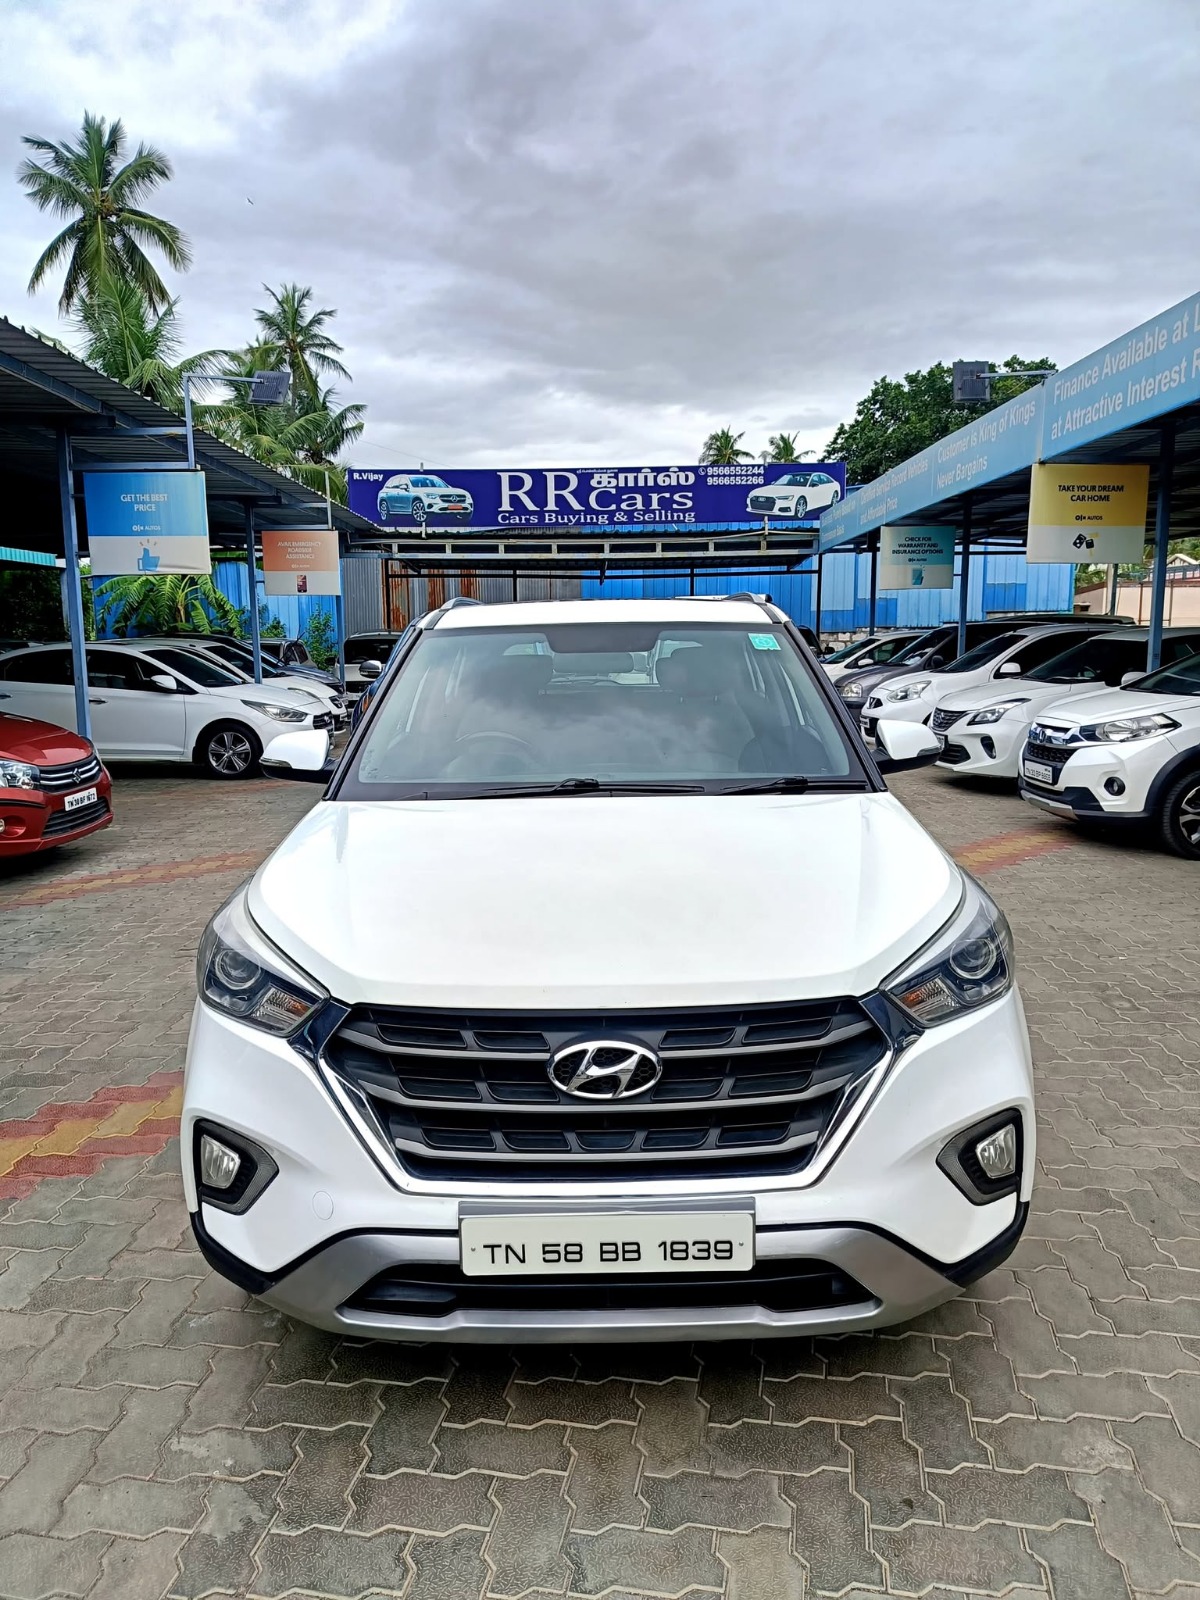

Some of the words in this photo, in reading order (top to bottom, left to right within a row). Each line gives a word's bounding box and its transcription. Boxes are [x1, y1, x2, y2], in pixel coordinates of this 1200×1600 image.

[1054, 365, 1099, 405] Finance
[1101, 326, 1168, 380] Available
[1172, 311, 1189, 344] at
[1051, 416, 1062, 440] at
[1063, 391, 1123, 435] Attractive
[1127, 356, 1187, 407] Interest
[937, 435, 970, 463] Customer
[970, 430, 978, 448] is
[979, 421, 997, 442] King
[998, 410, 1008, 433] of
[1009, 400, 1036, 428] Kings
[353, 472, 384, 481] R.Vijay
[706, 466, 764, 476] 9566552244
[937, 469, 955, 490] Never
[956, 455, 988, 481] Bargains
[706, 476, 764, 486] 9566552266
[120, 494, 135, 502] GET
[497, 471, 585, 511] RR
[588, 488, 693, 511] Cars
[134, 504, 156, 512] PRICE
[497, 513, 538, 524] Cars
[544, 512, 609, 525] Buying
[613, 511, 629, 522] &
[633, 510, 696, 523] Selling
[483, 1243, 526, 1264] TN
[542, 1243, 583, 1263] 58
[599, 1242, 641, 1262] BB
[658, 1240, 733, 1261] 1839
